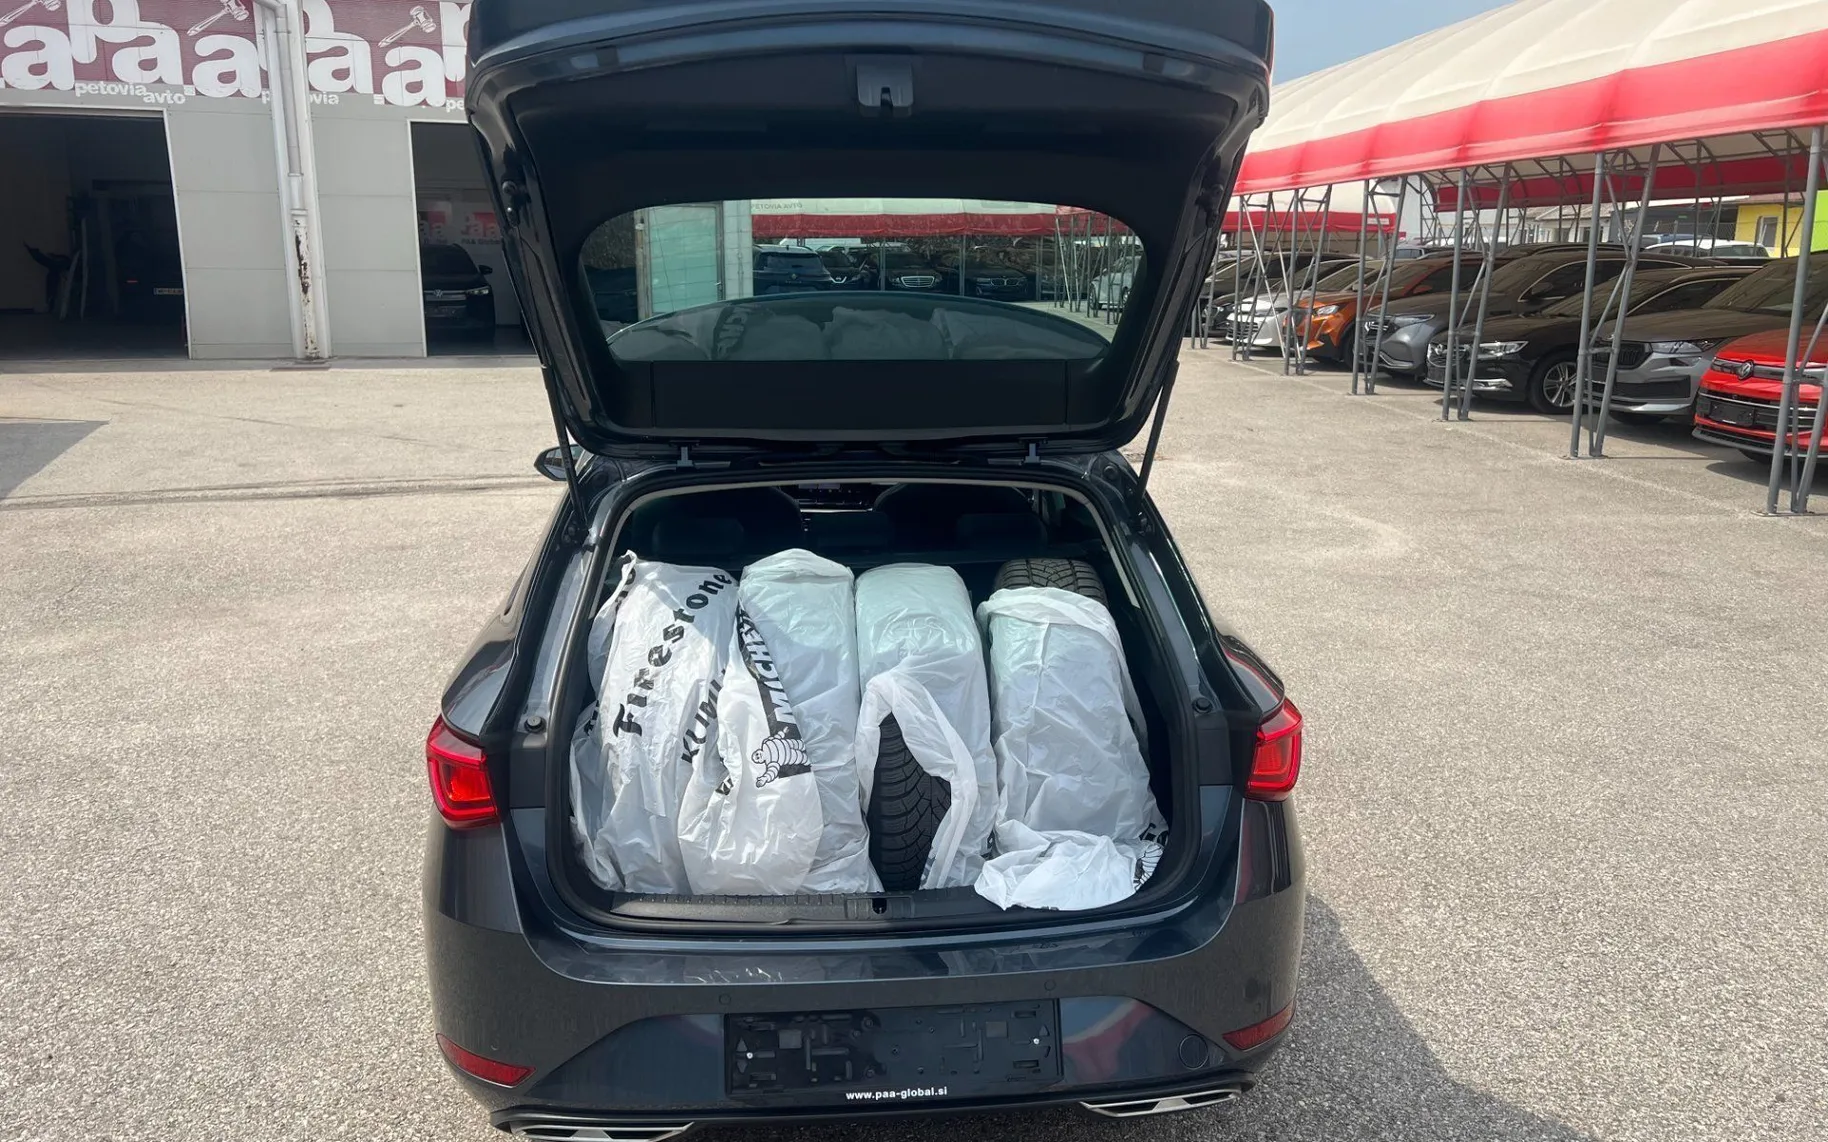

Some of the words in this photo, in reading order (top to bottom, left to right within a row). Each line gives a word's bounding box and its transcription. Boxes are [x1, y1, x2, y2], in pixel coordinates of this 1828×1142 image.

[75, 80, 147, 97] petovia
[143, 90, 186, 104] avto
[612, 573, 733, 738] Firestone
[846, 1086, 948, 1101] www.paa-global.si
